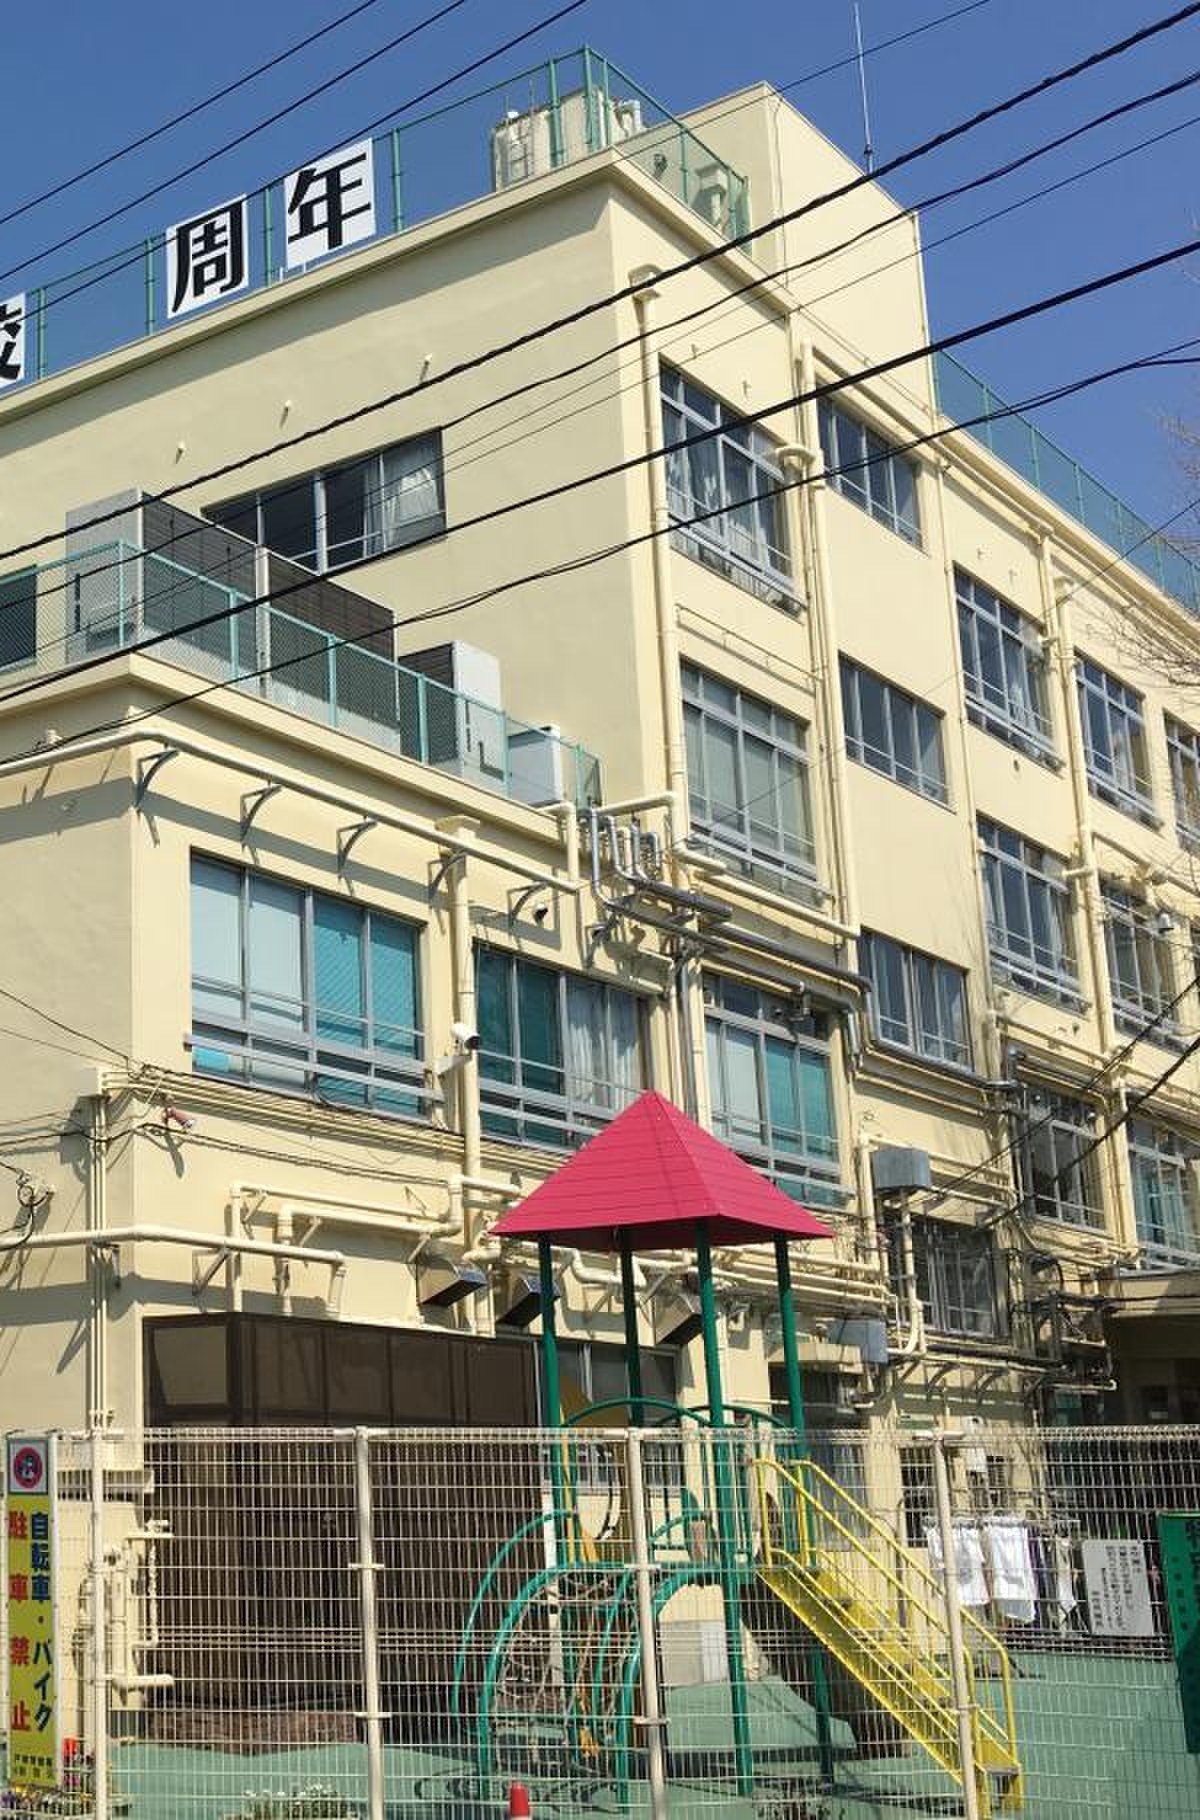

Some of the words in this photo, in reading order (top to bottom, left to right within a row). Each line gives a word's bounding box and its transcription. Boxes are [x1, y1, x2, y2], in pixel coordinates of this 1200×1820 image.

[172, 153, 372, 313] 周年
[8, 1510, 31, 1732] 駐車禁止
[31, 1511, 53, 1733] 自転車・バイク
